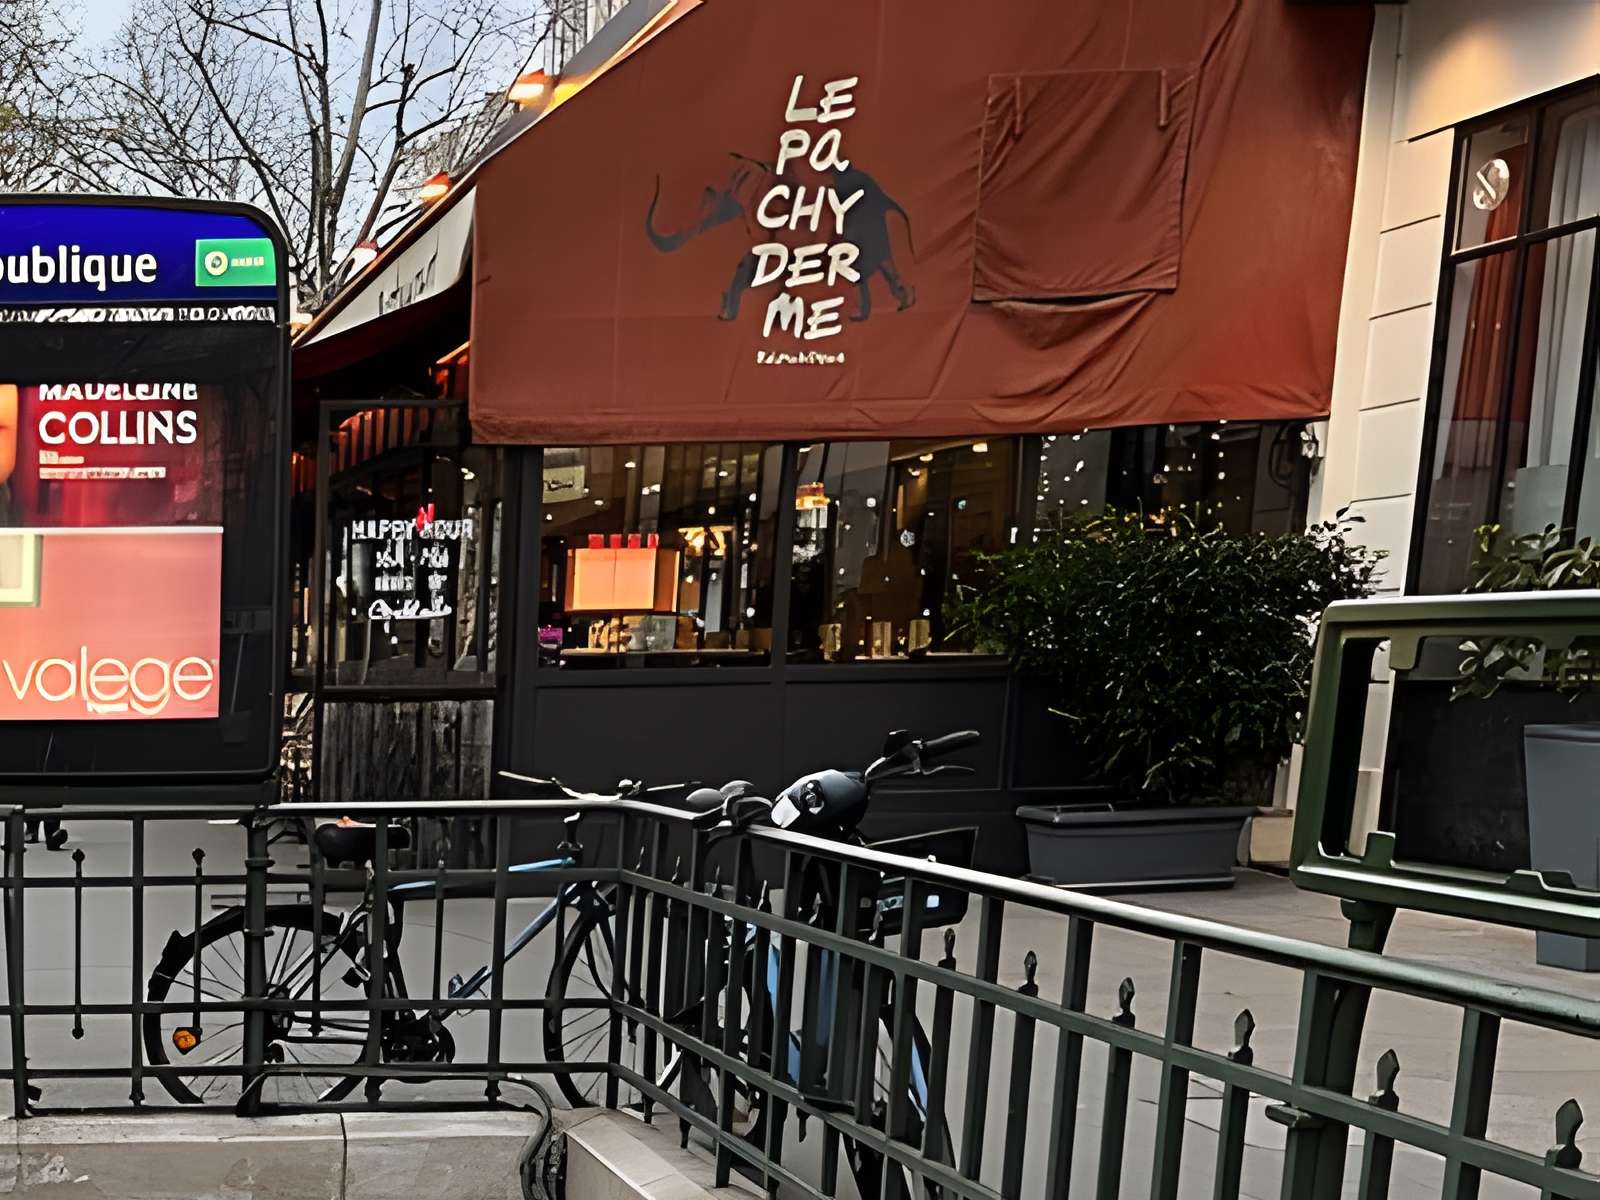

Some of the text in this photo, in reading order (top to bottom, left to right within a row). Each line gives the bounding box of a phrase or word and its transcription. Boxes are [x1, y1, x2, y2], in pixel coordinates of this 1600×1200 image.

[784, 75, 859, 123] LE
[756, 184, 864, 234] CHY
[750, 242, 861, 287] DER
[762, 292, 845, 340] ME
[38, 410, 198, 445] COLLINS
[2, 645, 214, 715] valege
